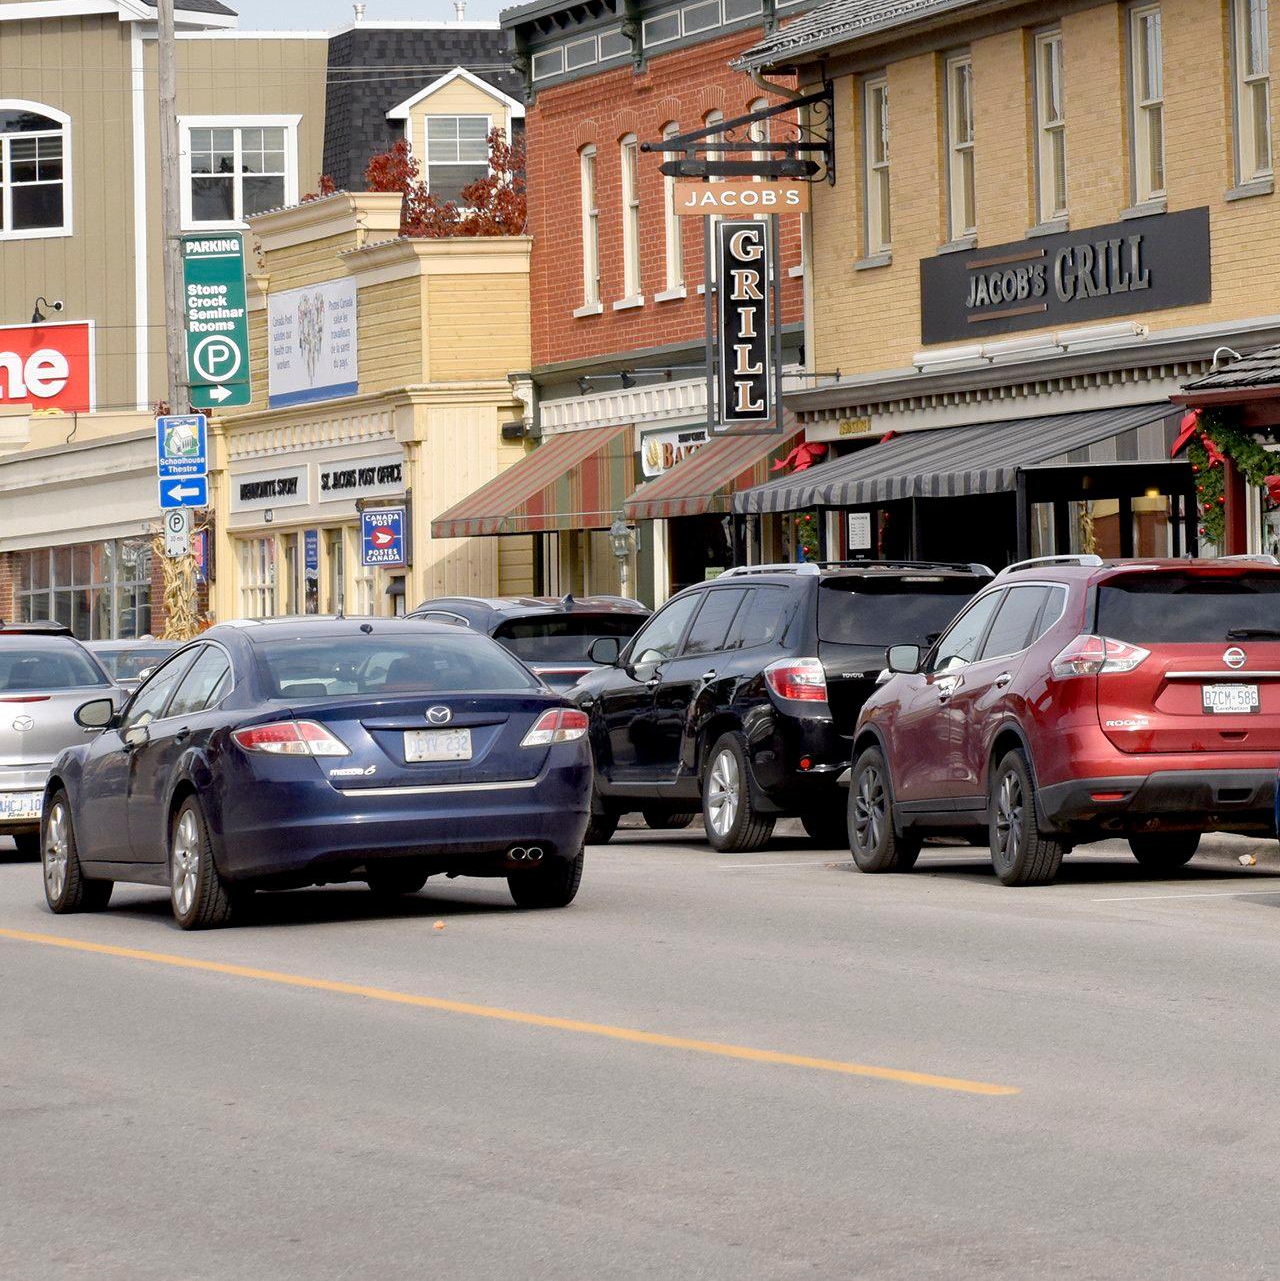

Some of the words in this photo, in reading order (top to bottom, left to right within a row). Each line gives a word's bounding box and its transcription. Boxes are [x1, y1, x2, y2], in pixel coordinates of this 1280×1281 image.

[684, 190, 800, 207] JACOB'S
[186, 239, 240, 254] PARKING
[966, 264, 1046, 308] JACOB'S
[1054, 235, 1150, 303] GRILL
[188, 284, 228, 296] Stone
[188, 295, 228, 308] Crock
[189, 307, 245, 320] Seminar
[189, 320, 236, 333] Rooms
[729, 230, 764, 412] GRILL
[207, 345, 230, 374] P
[160, 457, 205, 466] Schoolhouse
[366, 513, 399, 522] CANADA
[366, 554, 400, 563] CANADA
[368, 548, 398, 556] POSTES
[1106, 719, 1149, 727] ROGUE
